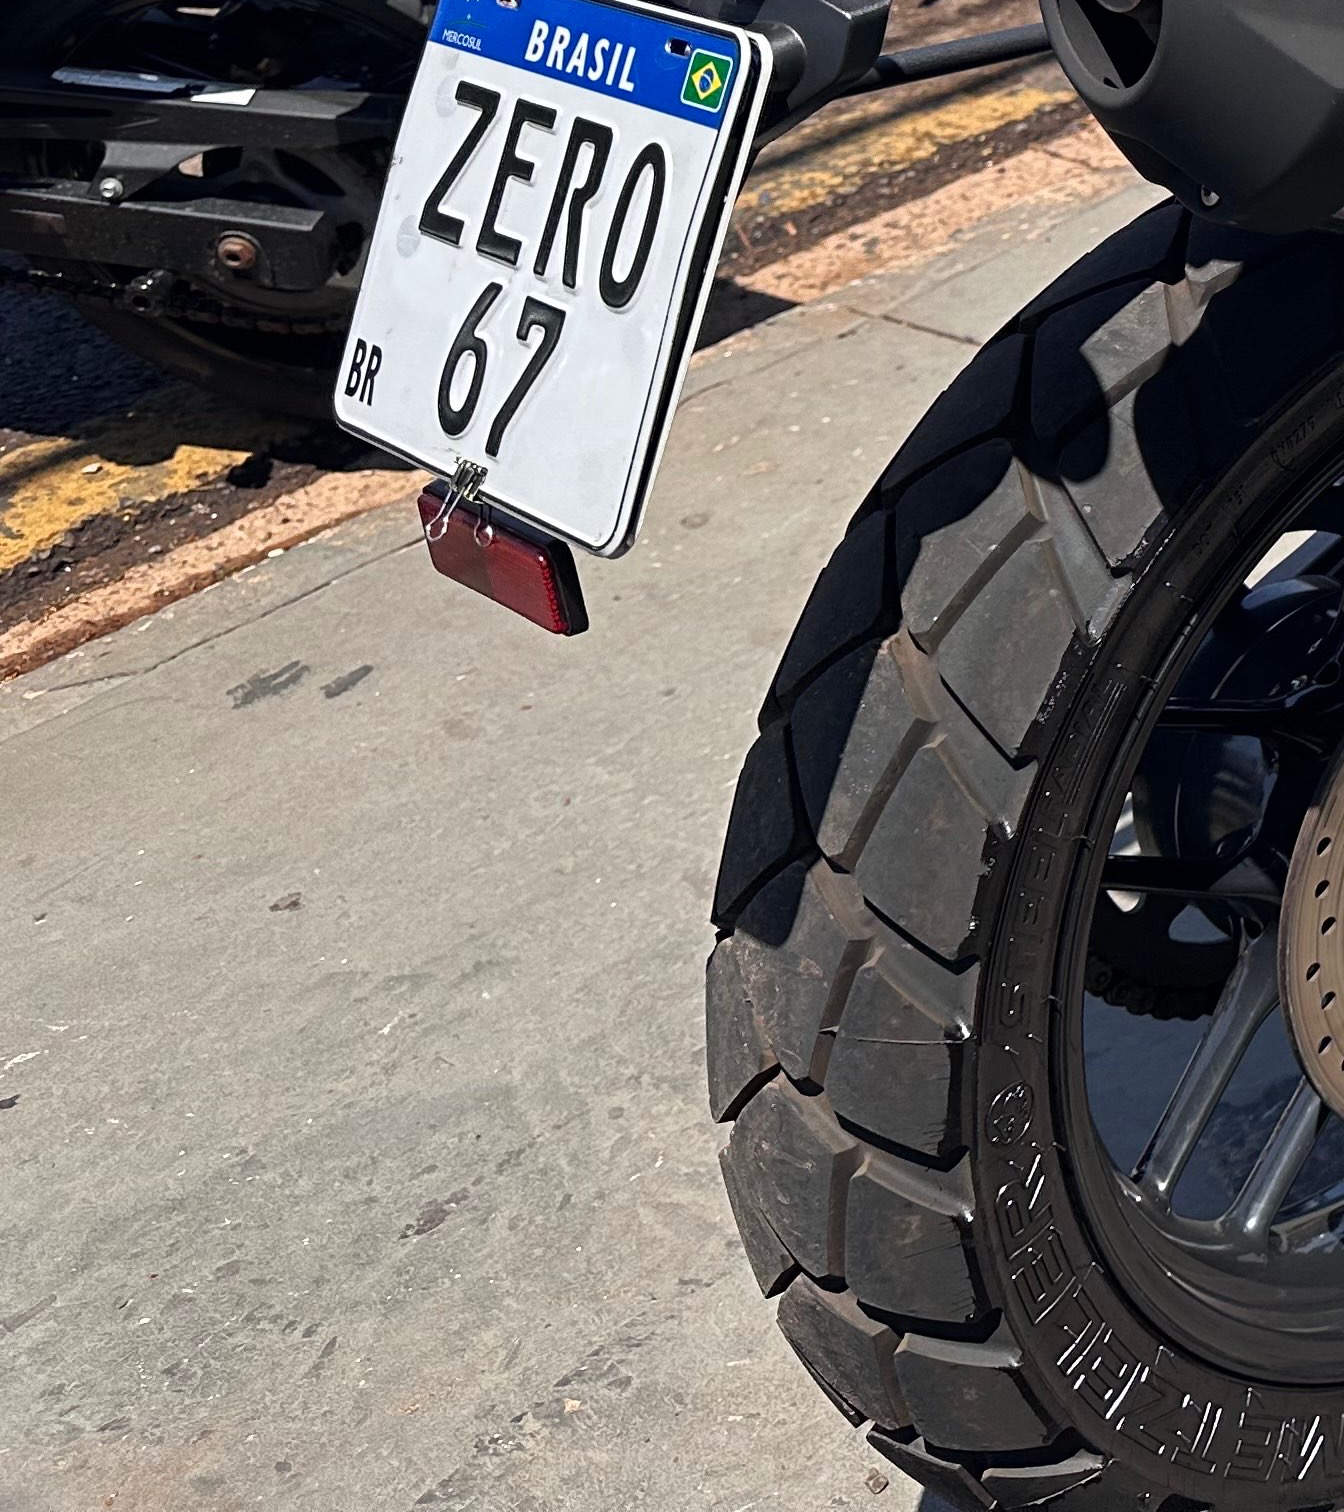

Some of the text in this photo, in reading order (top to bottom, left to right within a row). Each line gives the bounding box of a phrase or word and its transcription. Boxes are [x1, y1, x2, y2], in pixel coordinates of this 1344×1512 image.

[441, 28, 482, 52] MERCOSUL
[524, 19, 637, 92] BRASIL
[418, 80, 668, 309] ZERO
[344, 338, 383, 407] BR
[437, 282, 567, 458] 67
